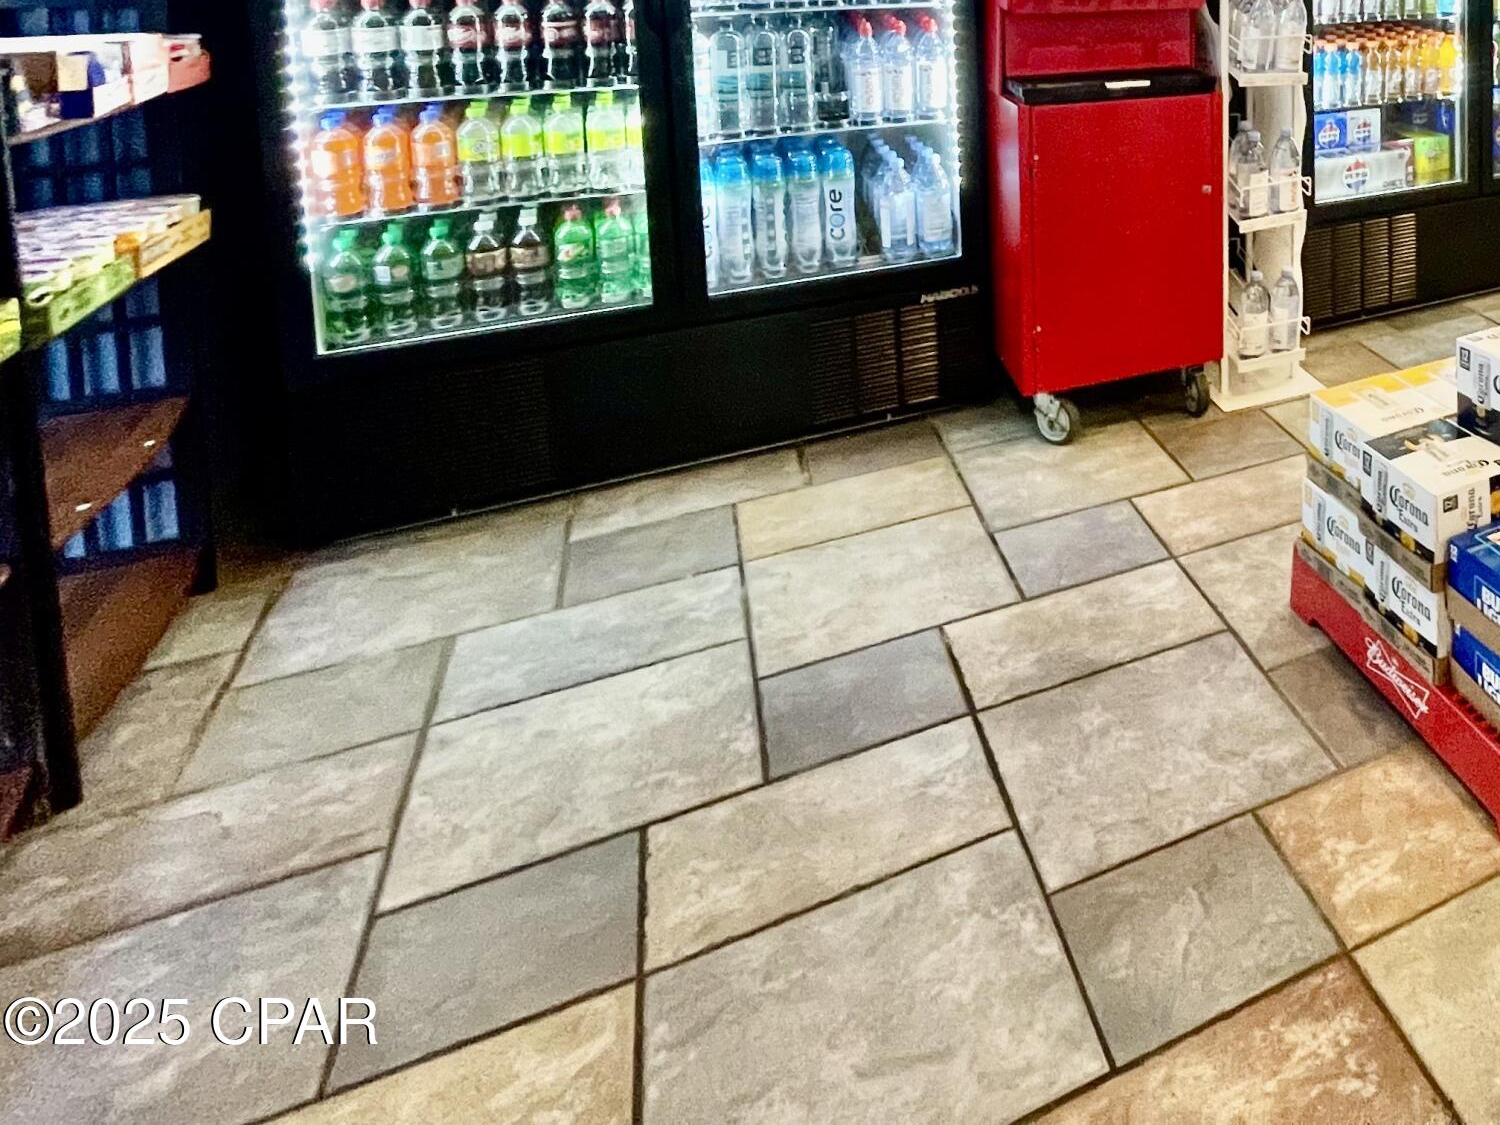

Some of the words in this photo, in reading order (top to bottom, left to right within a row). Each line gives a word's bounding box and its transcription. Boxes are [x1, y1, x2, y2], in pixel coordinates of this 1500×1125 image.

[829, 188, 846, 240] core
[1389, 484, 1429, 526] Corona
[1327, 516, 1361, 555] Corona
[1391, 576, 1431, 621] Corona
